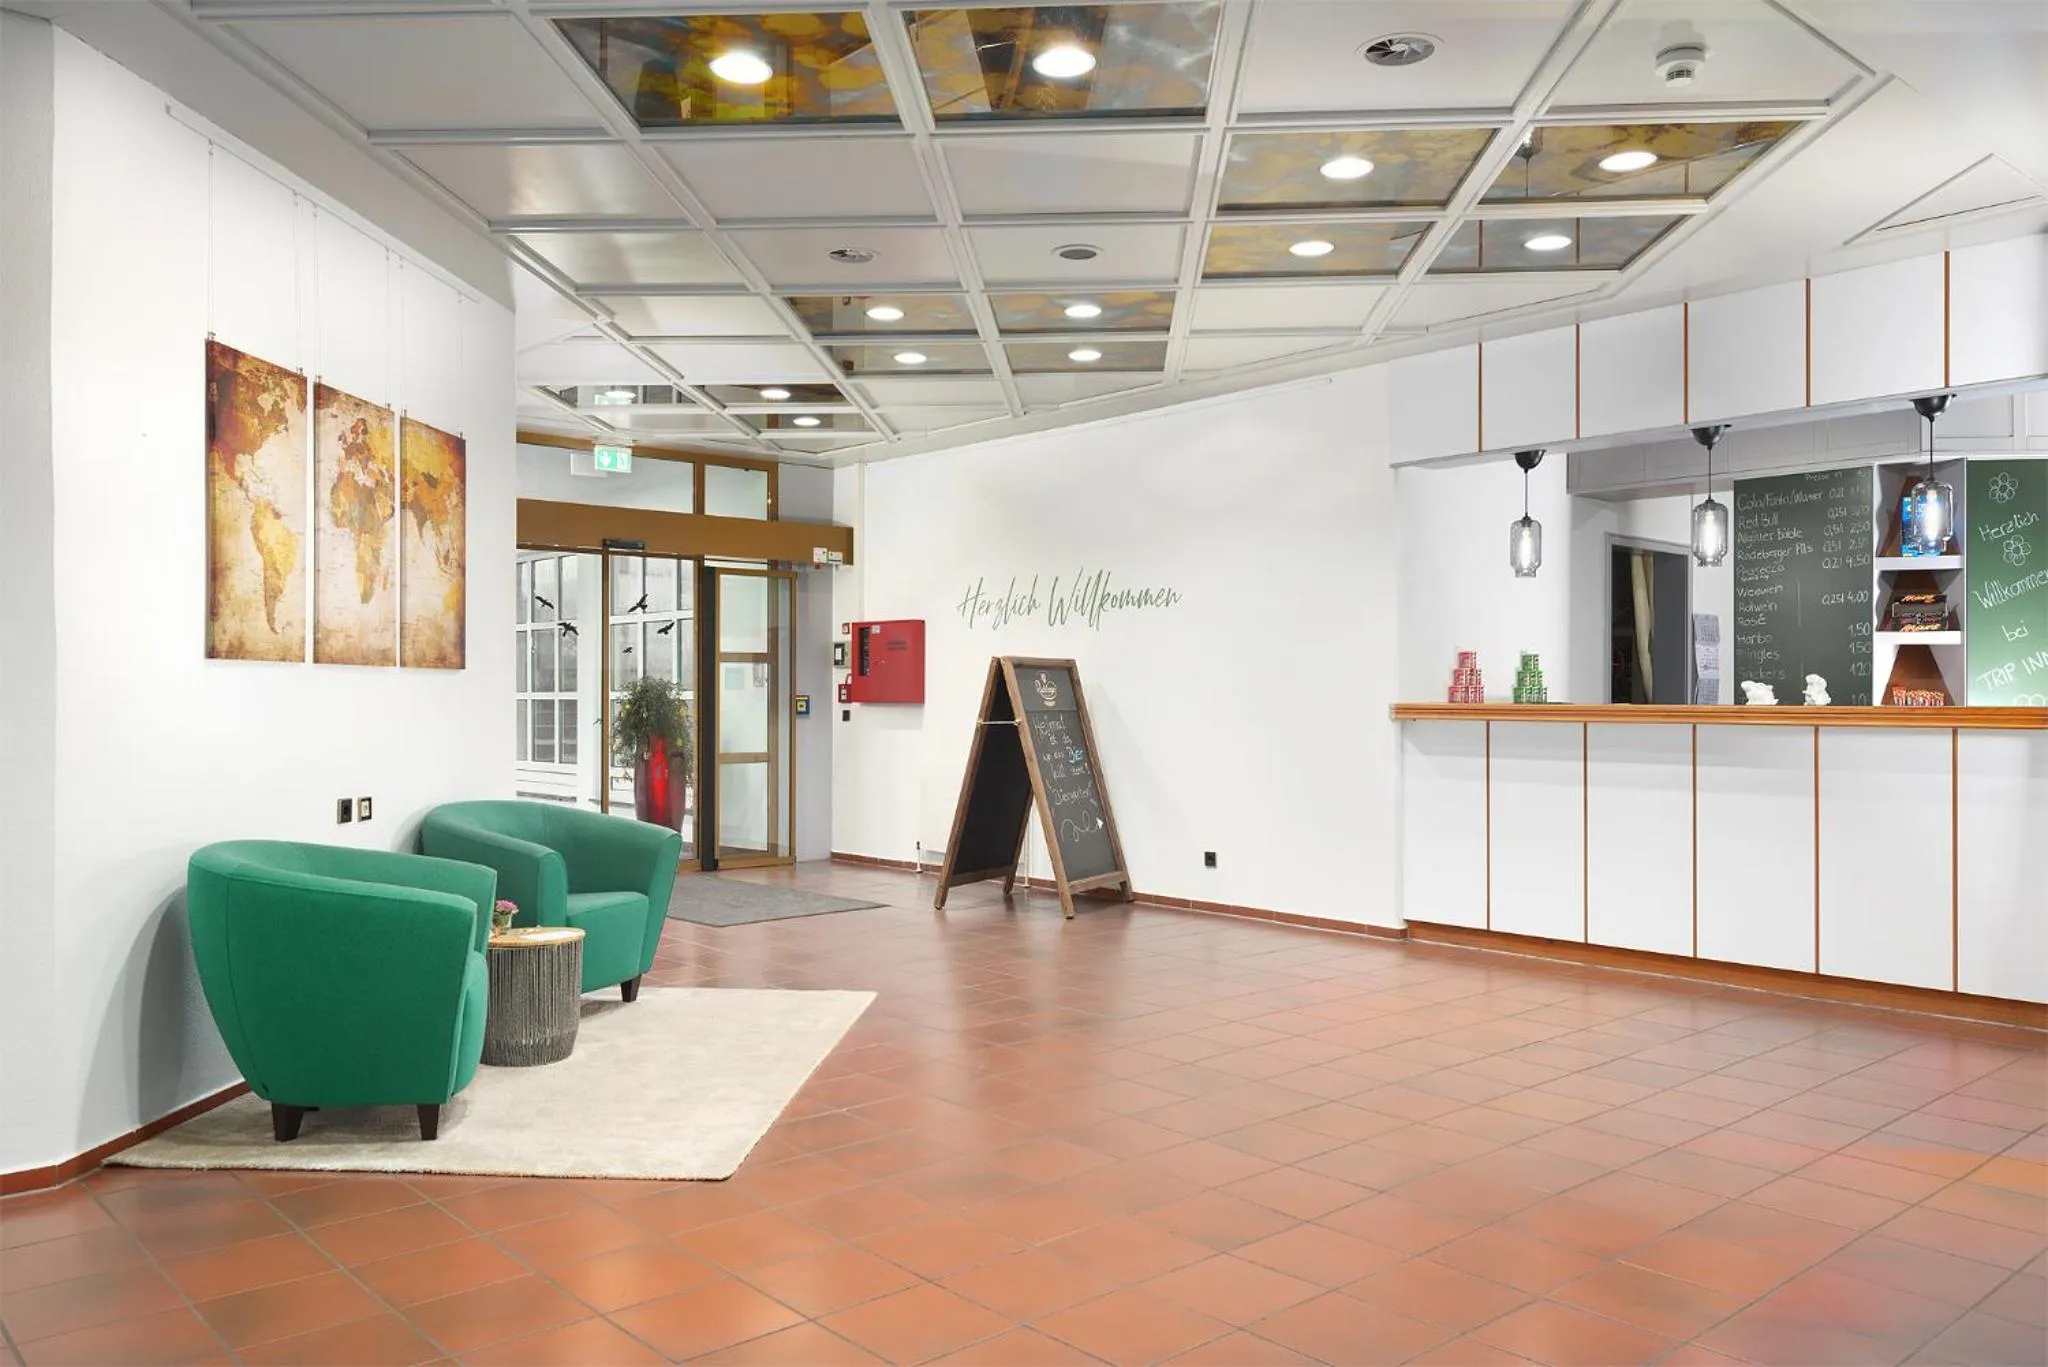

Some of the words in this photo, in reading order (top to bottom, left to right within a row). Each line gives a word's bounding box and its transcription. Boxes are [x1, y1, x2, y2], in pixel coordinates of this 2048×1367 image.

[1738, 511, 1758, 529] Red
[1760, 511, 1778, 527] Bull
[1977, 512, 2040, 542] Herzlich
[957, 574, 1041, 630] Herzlich
[1047, 566, 1182, 632] Willkommen
[2000, 618, 2029, 642] bei
[1975, 662, 2016, 692] TRIP
